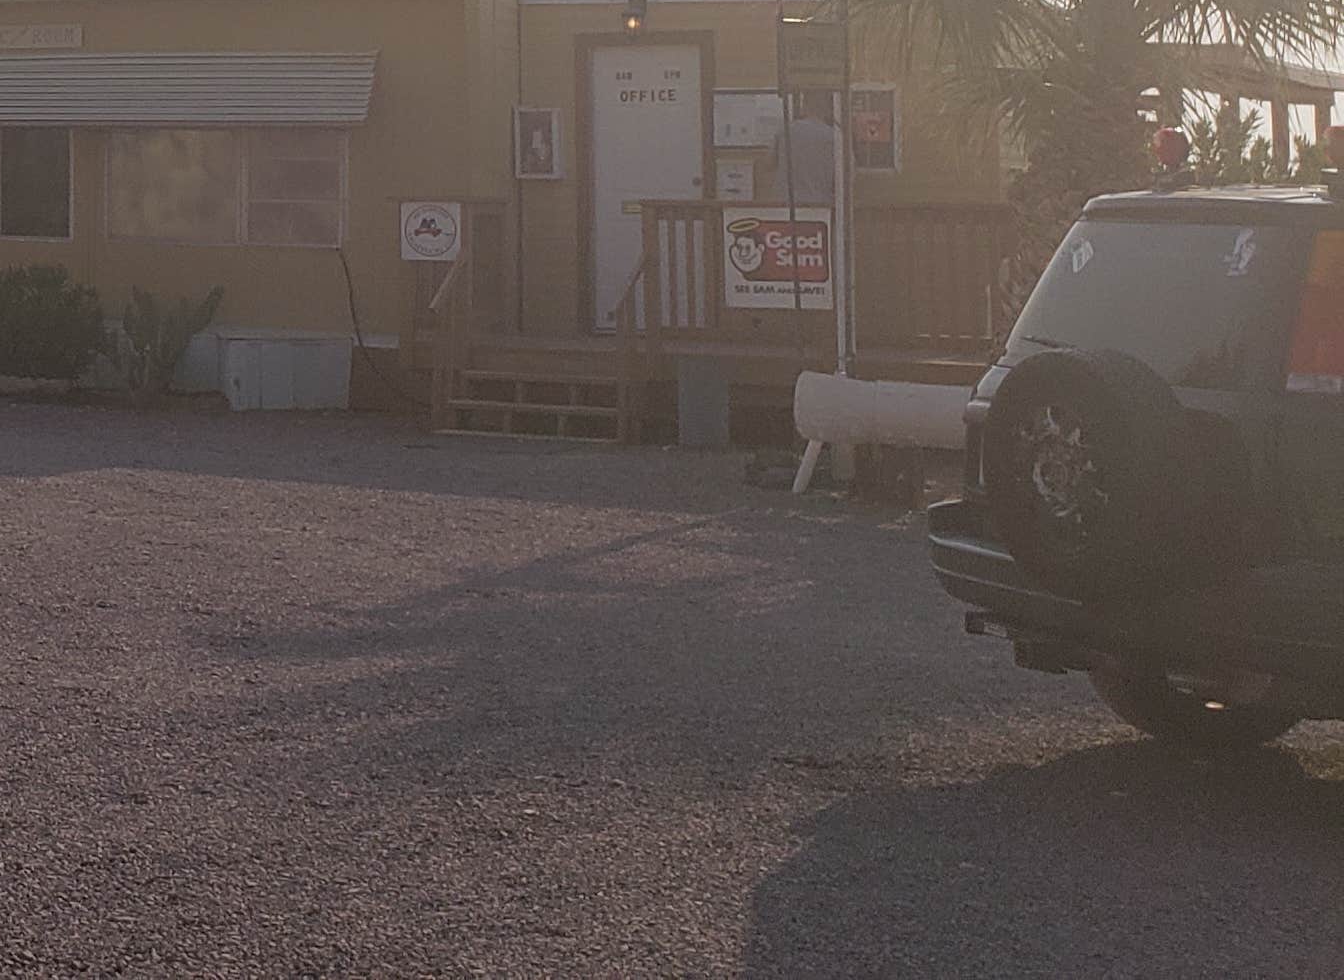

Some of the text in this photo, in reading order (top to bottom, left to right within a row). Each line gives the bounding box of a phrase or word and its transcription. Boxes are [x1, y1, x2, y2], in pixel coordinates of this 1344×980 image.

[619, 88, 678, 103] OFFICE
[765, 229, 823, 249] Good
[775, 248, 823, 267] Sam
